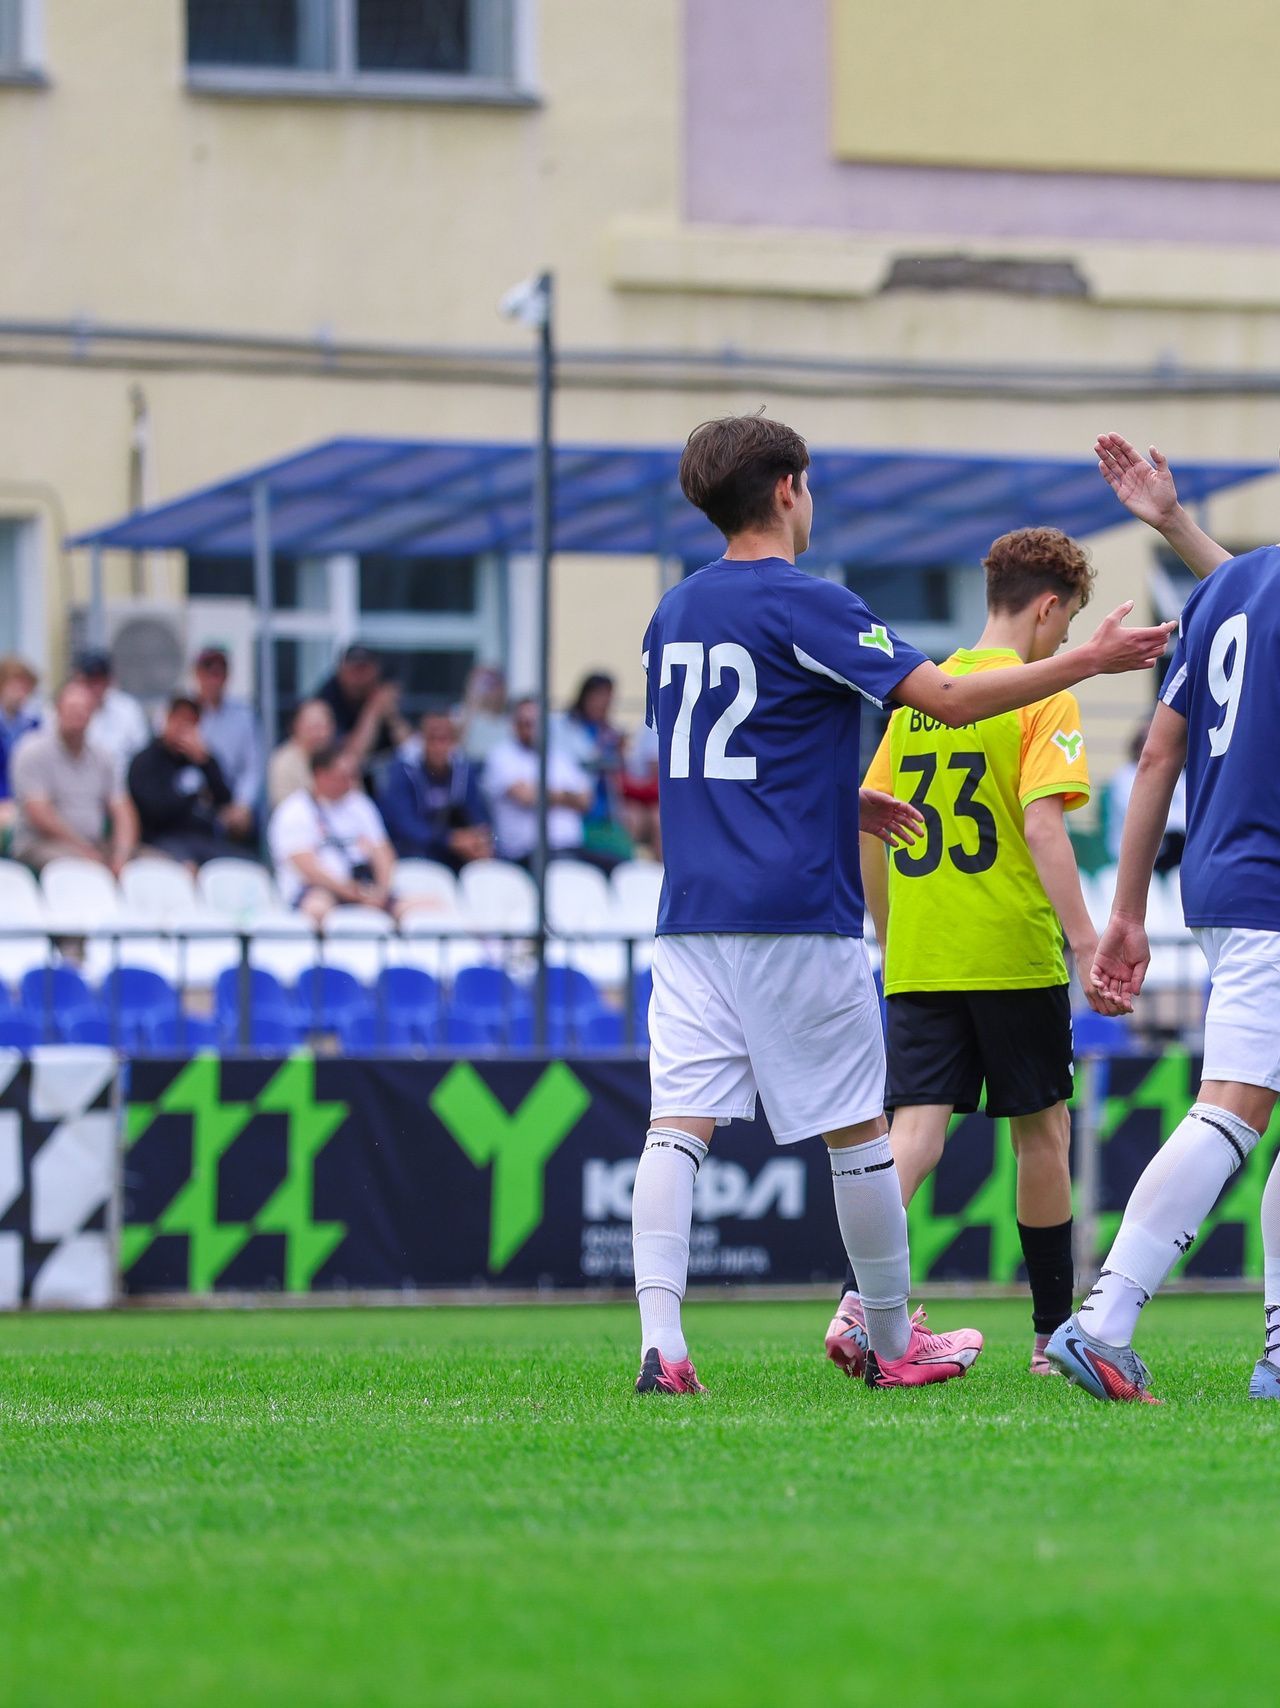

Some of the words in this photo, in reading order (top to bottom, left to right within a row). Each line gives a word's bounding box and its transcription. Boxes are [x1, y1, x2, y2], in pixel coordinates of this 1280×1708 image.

[659, 641, 758, 780] 72
[1208, 612, 1248, 758] 9
[894, 752, 998, 878] 33
